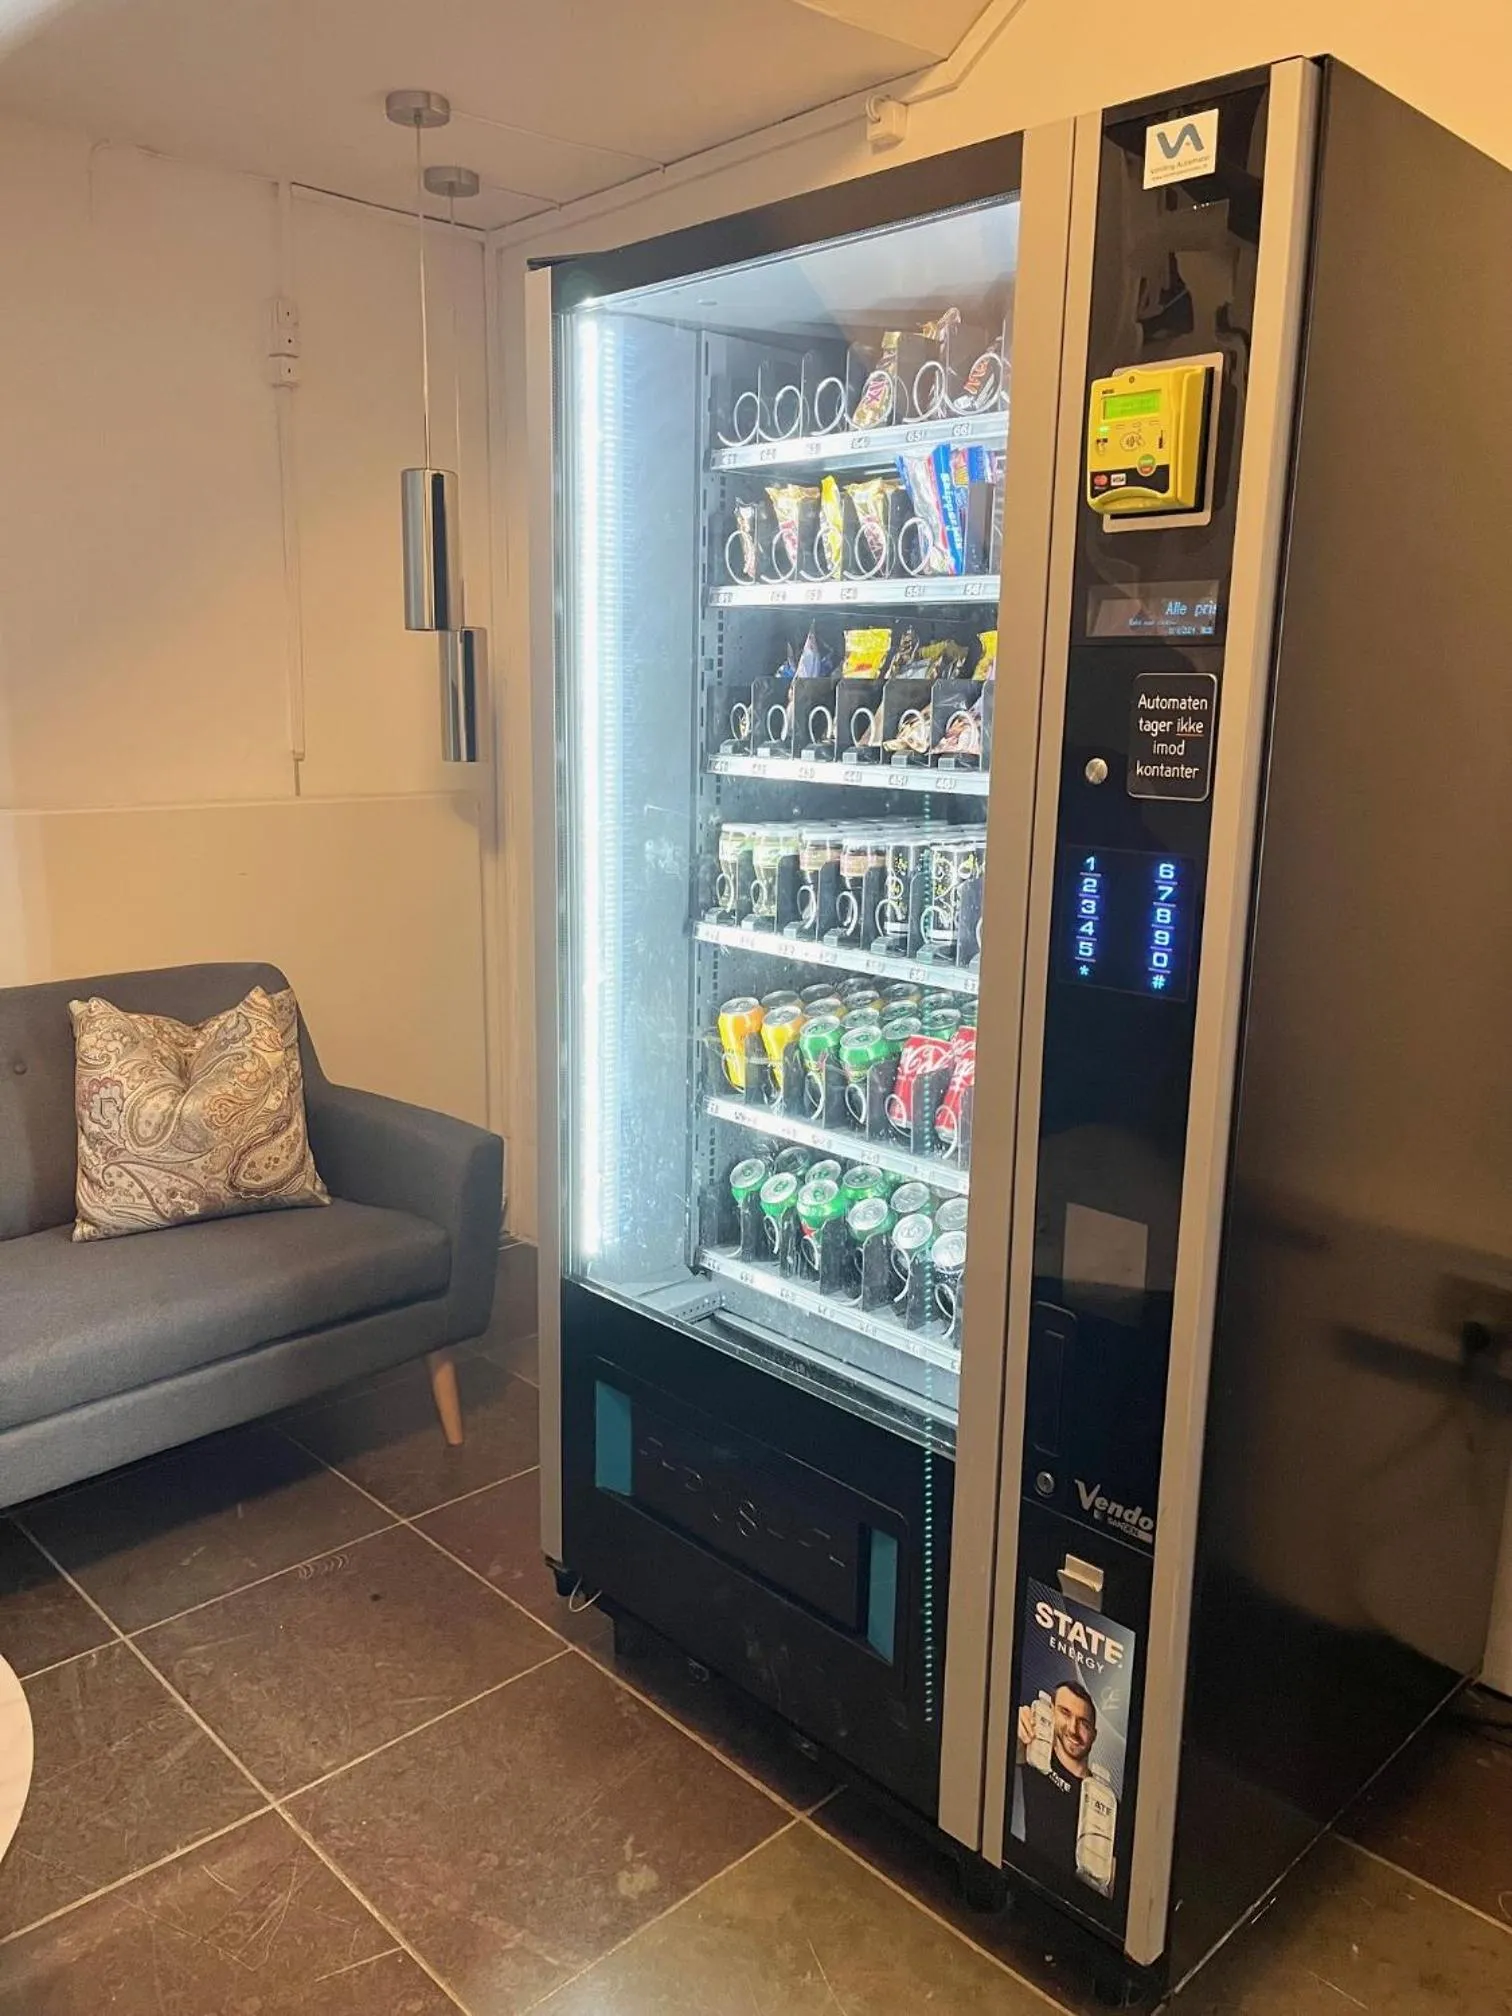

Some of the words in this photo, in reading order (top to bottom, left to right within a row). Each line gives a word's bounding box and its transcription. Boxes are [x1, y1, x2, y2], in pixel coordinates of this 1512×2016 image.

[1165, 601, 1187, 616] Alle
[1137, 693, 1208, 711] Automaten
[1138, 717, 1173, 737] tager
[1176, 717, 1204, 734] ikke
[1152, 739, 1185, 756] imod
[1136, 760, 1199, 779] kontanter
[1085, 856, 1095, 871] 1
[1159, 863, 1175, 879] 6
[1082, 878, 1097, 893] 2
[1158, 885, 1173, 901] 7
[1081, 899, 1096, 914] 3
[1156, 908, 1171, 924] 8
[1079, 921, 1094, 936] 4
[1154, 930, 1169, 946] 9
[1078, 941, 1093, 957] 5
[1152, 952, 1168, 968] 0
[1152, 974, 1166, 989] #
[1074, 1478, 1154, 1531] Vendo
[1049, 1637, 1105, 1674] ENERGY
